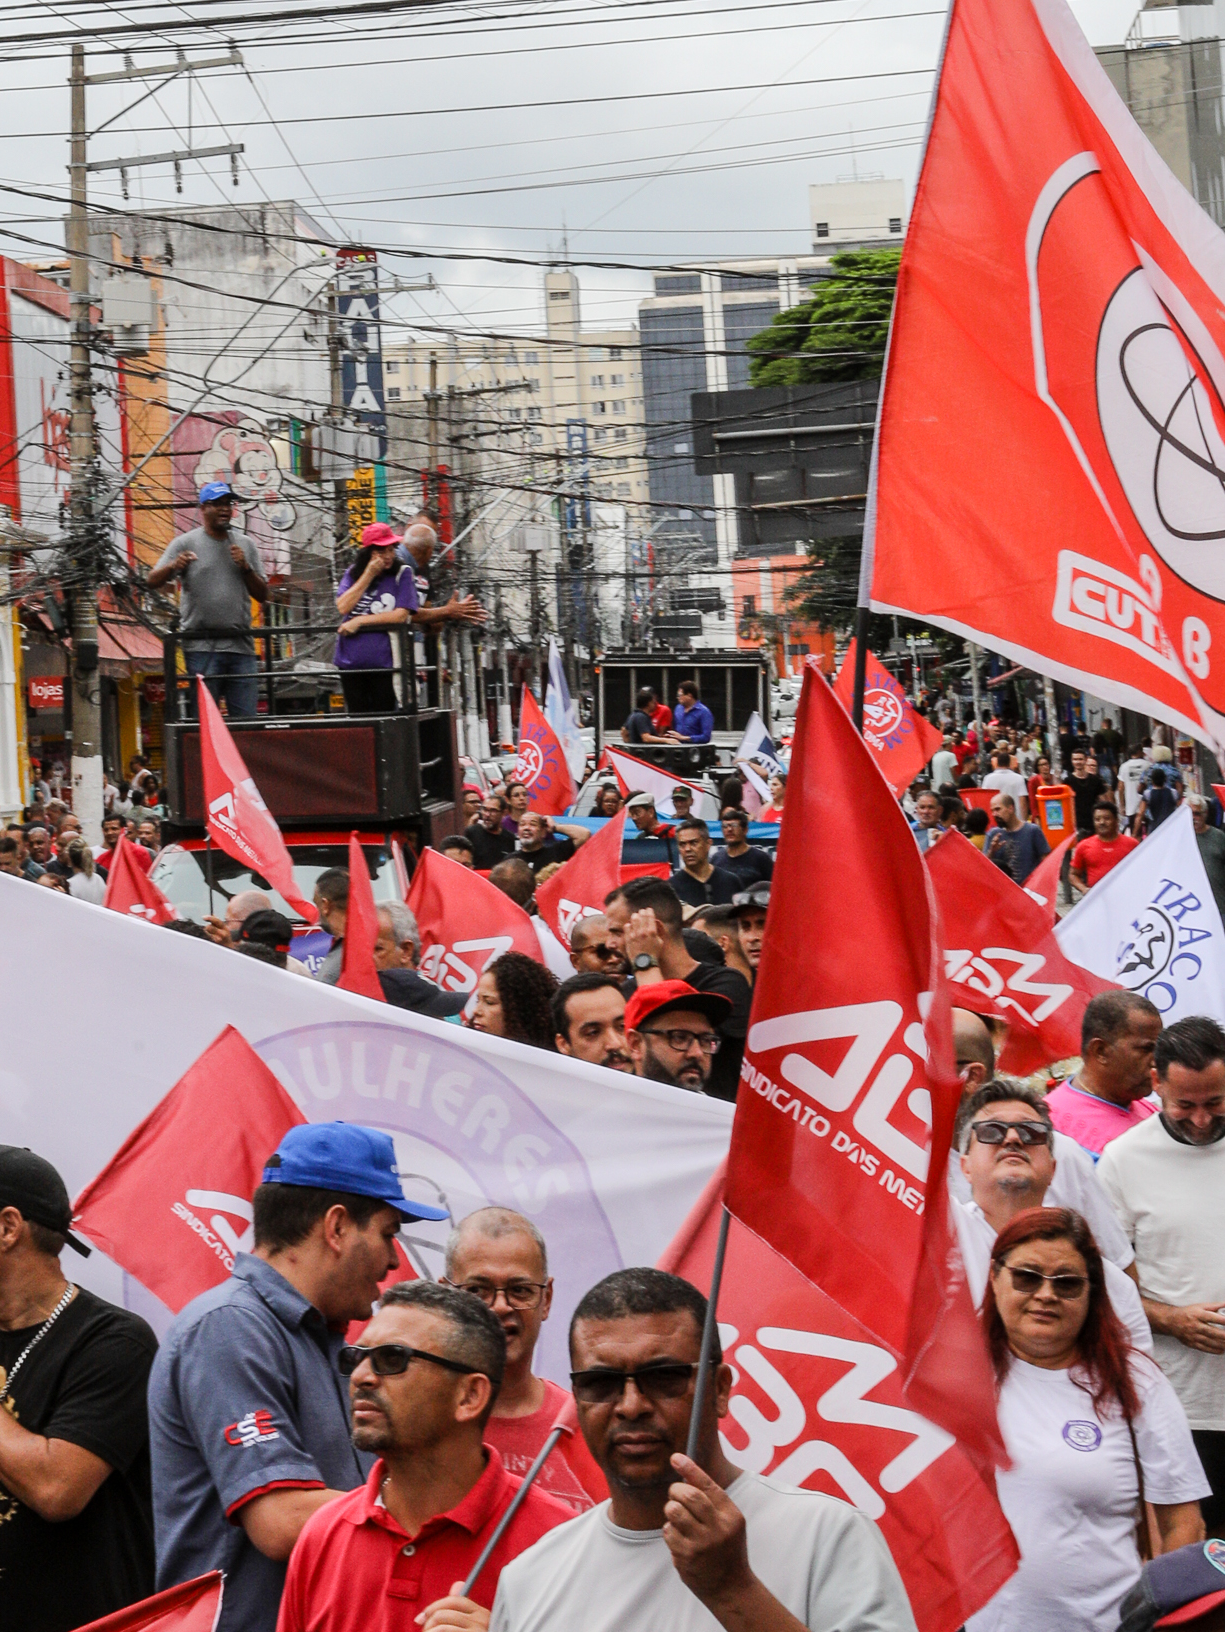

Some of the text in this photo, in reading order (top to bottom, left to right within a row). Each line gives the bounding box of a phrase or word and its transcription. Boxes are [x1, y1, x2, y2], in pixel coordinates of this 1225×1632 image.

[1072, 577, 1160, 648] CUT
[32, 682, 64, 699] lojas
[740, 1056, 831, 1138] SINDICATO
[170, 1202, 235, 1272] SINDICATO
